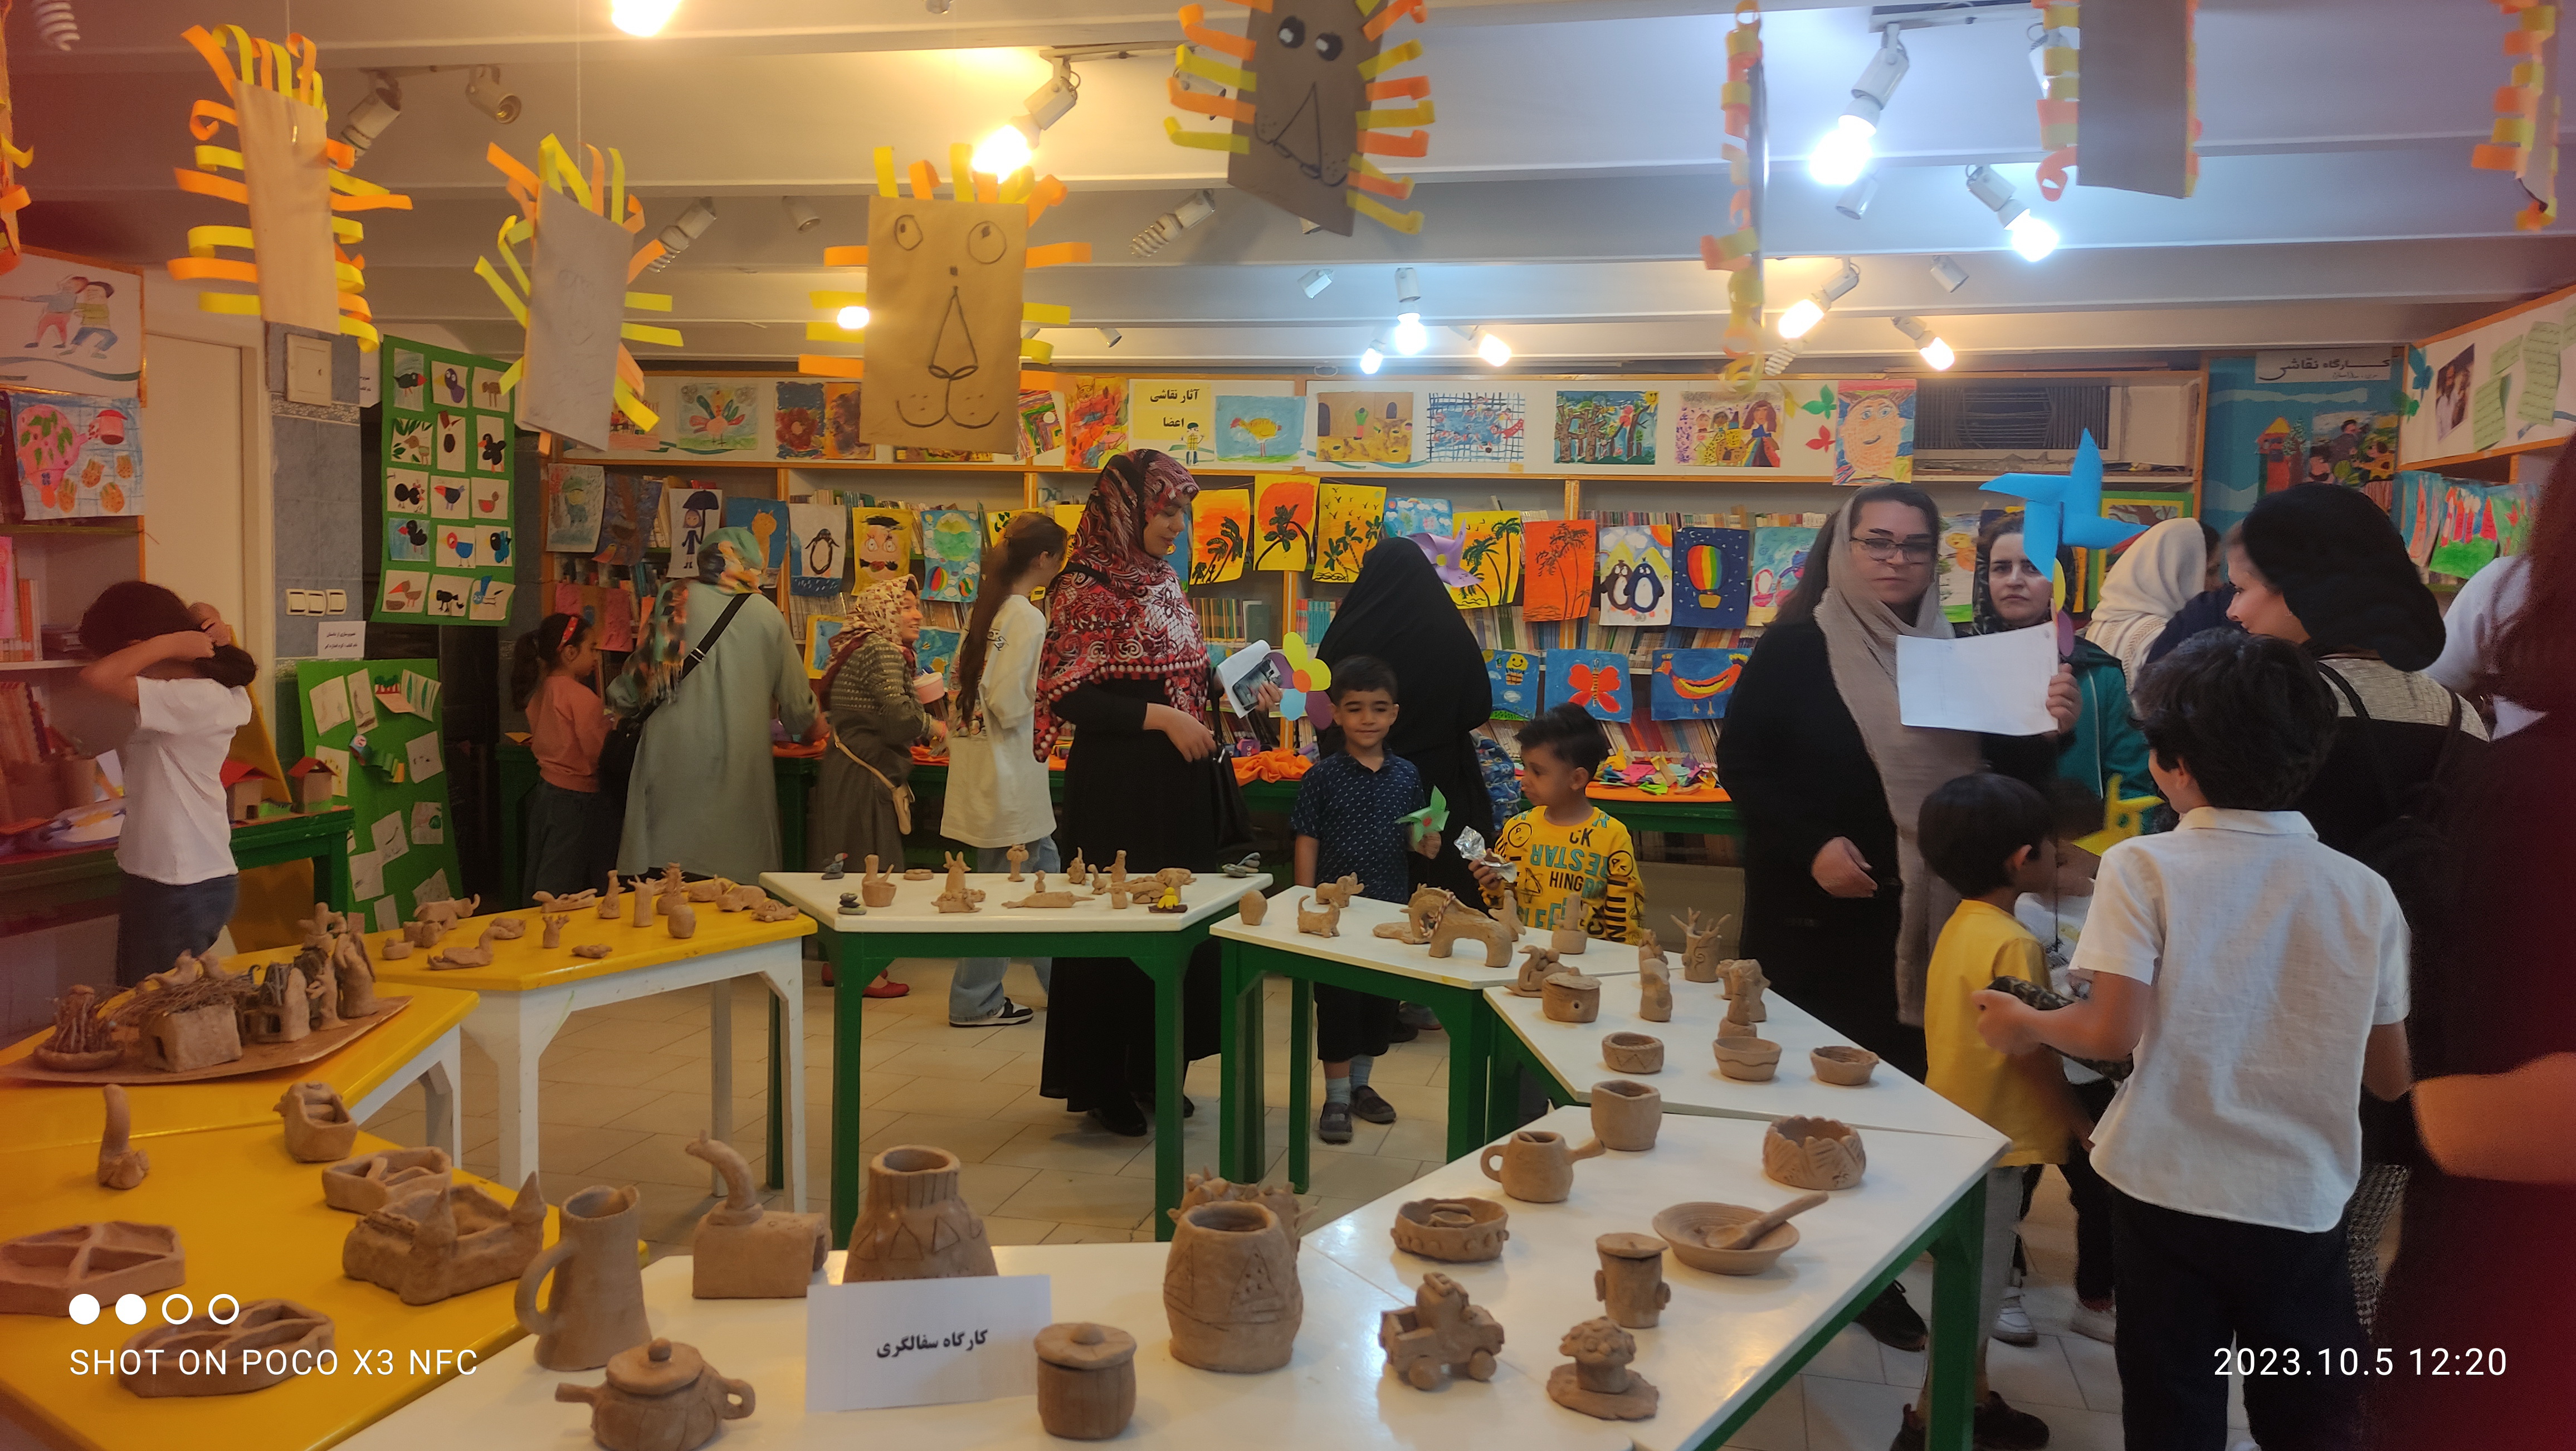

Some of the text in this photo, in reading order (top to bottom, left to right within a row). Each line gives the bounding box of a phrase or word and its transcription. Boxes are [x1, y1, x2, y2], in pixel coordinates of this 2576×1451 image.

[2259, 358, 2319, 381] نقاشی
[2323, 358, 2390, 370] کارگاه
[1150, 388, 1200, 403] آثار نقاشی
[1163, 417, 1184, 427] اعضا
[1549, 870, 1583, 892] HING
[876, 1328, 989, 1359] کارگاه سفالگری
